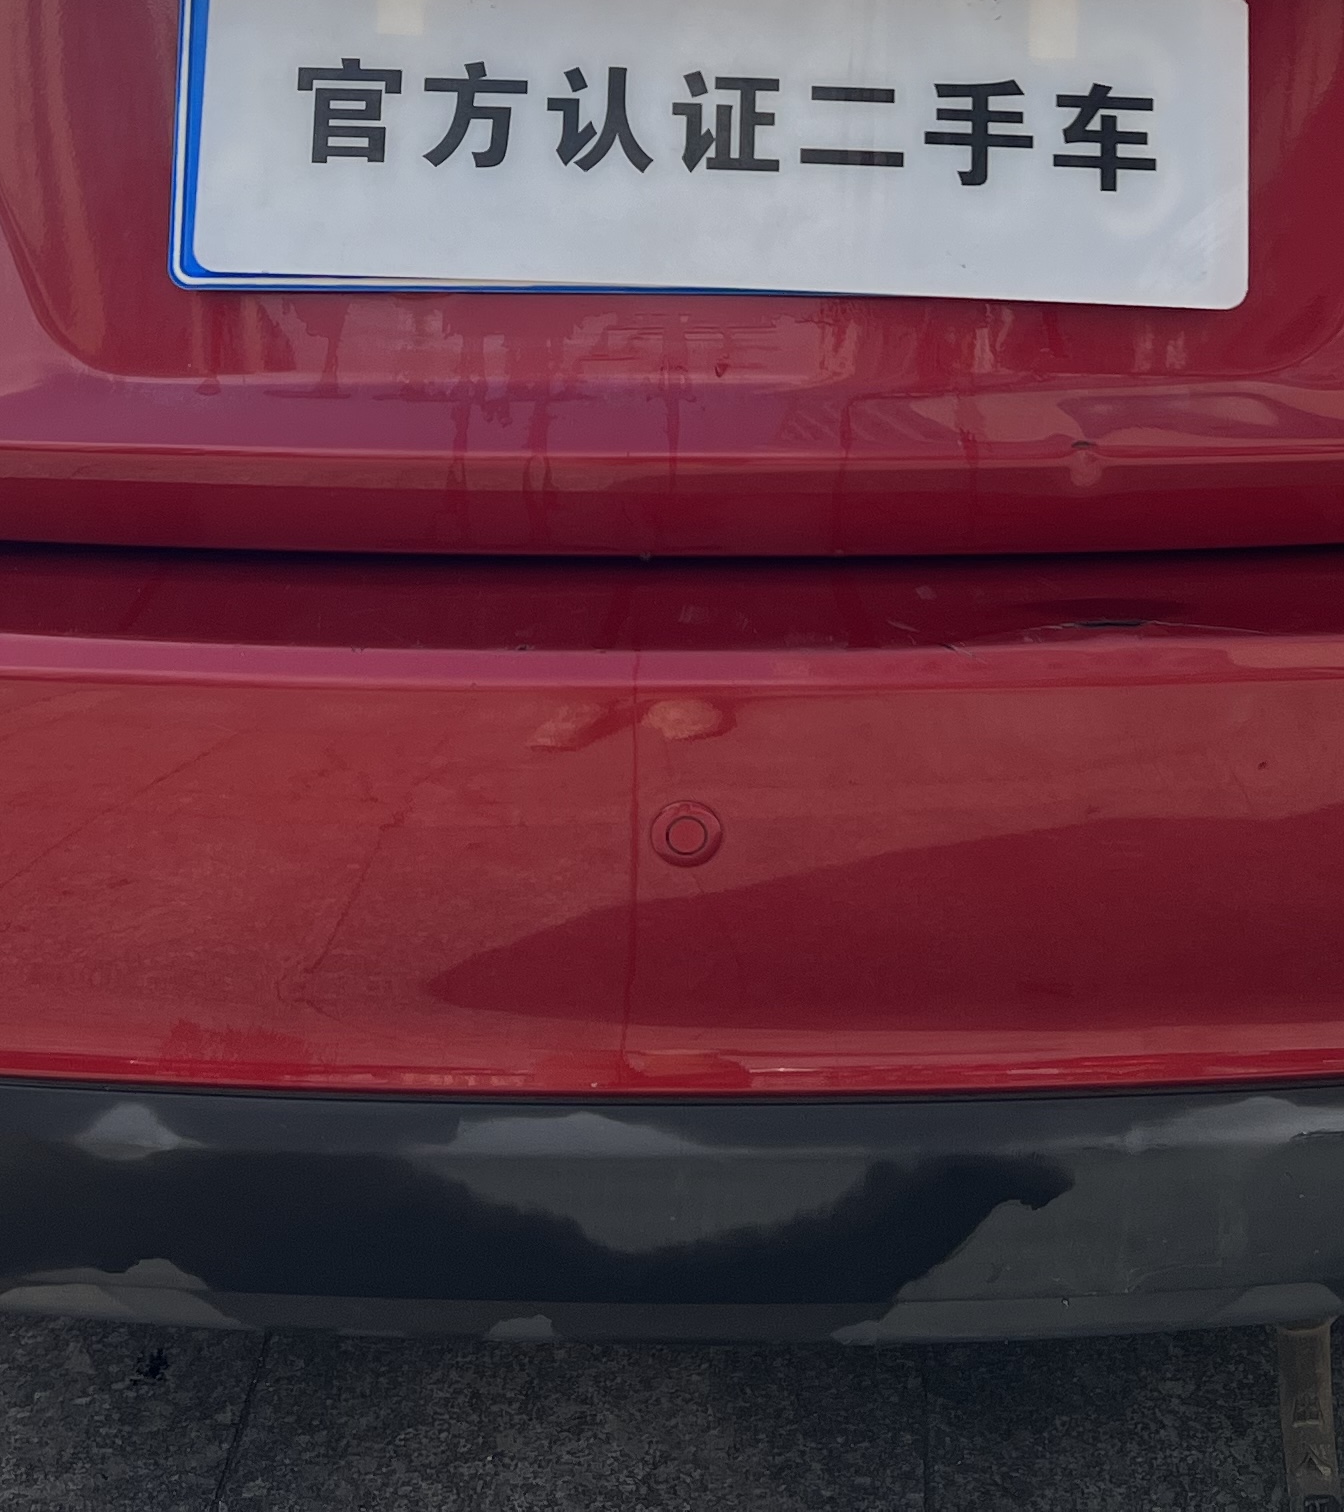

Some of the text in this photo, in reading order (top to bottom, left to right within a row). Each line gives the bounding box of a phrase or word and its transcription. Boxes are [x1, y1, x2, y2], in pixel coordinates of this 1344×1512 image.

[295, 56, 1160, 193] 官方认证二手车
